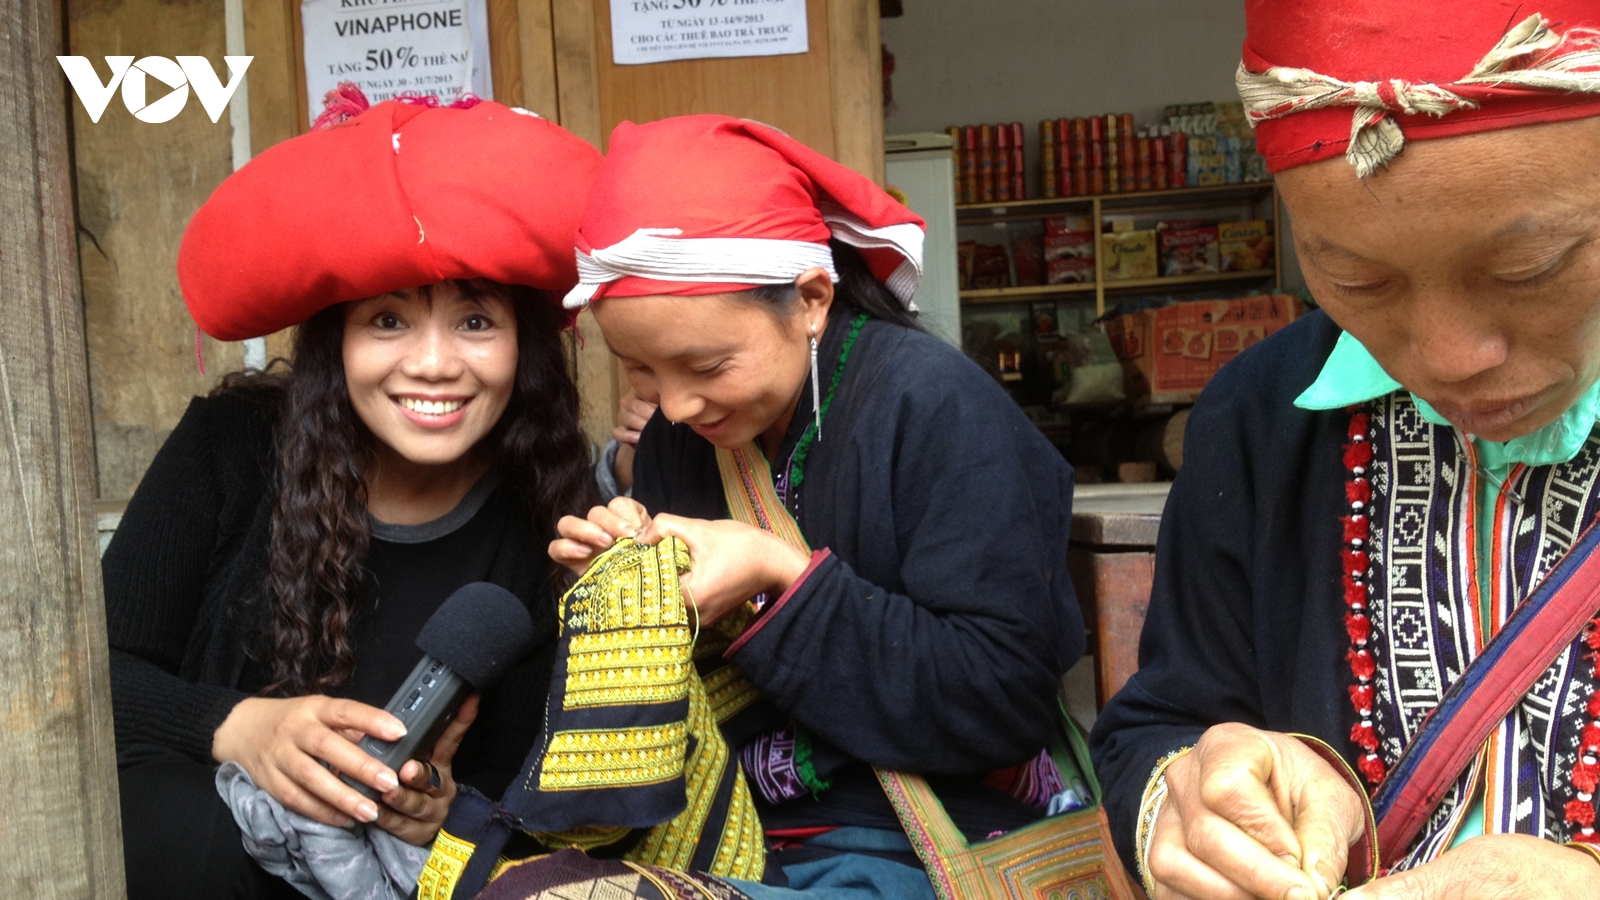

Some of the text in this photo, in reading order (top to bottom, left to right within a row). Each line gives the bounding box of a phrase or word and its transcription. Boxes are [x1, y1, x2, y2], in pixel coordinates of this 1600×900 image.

[335, 9, 462, 37] VINAPHONE
[630, 34, 654, 44] CHO
[655, 32, 678, 43] CÁC
[710, 29, 732, 39] BAO
